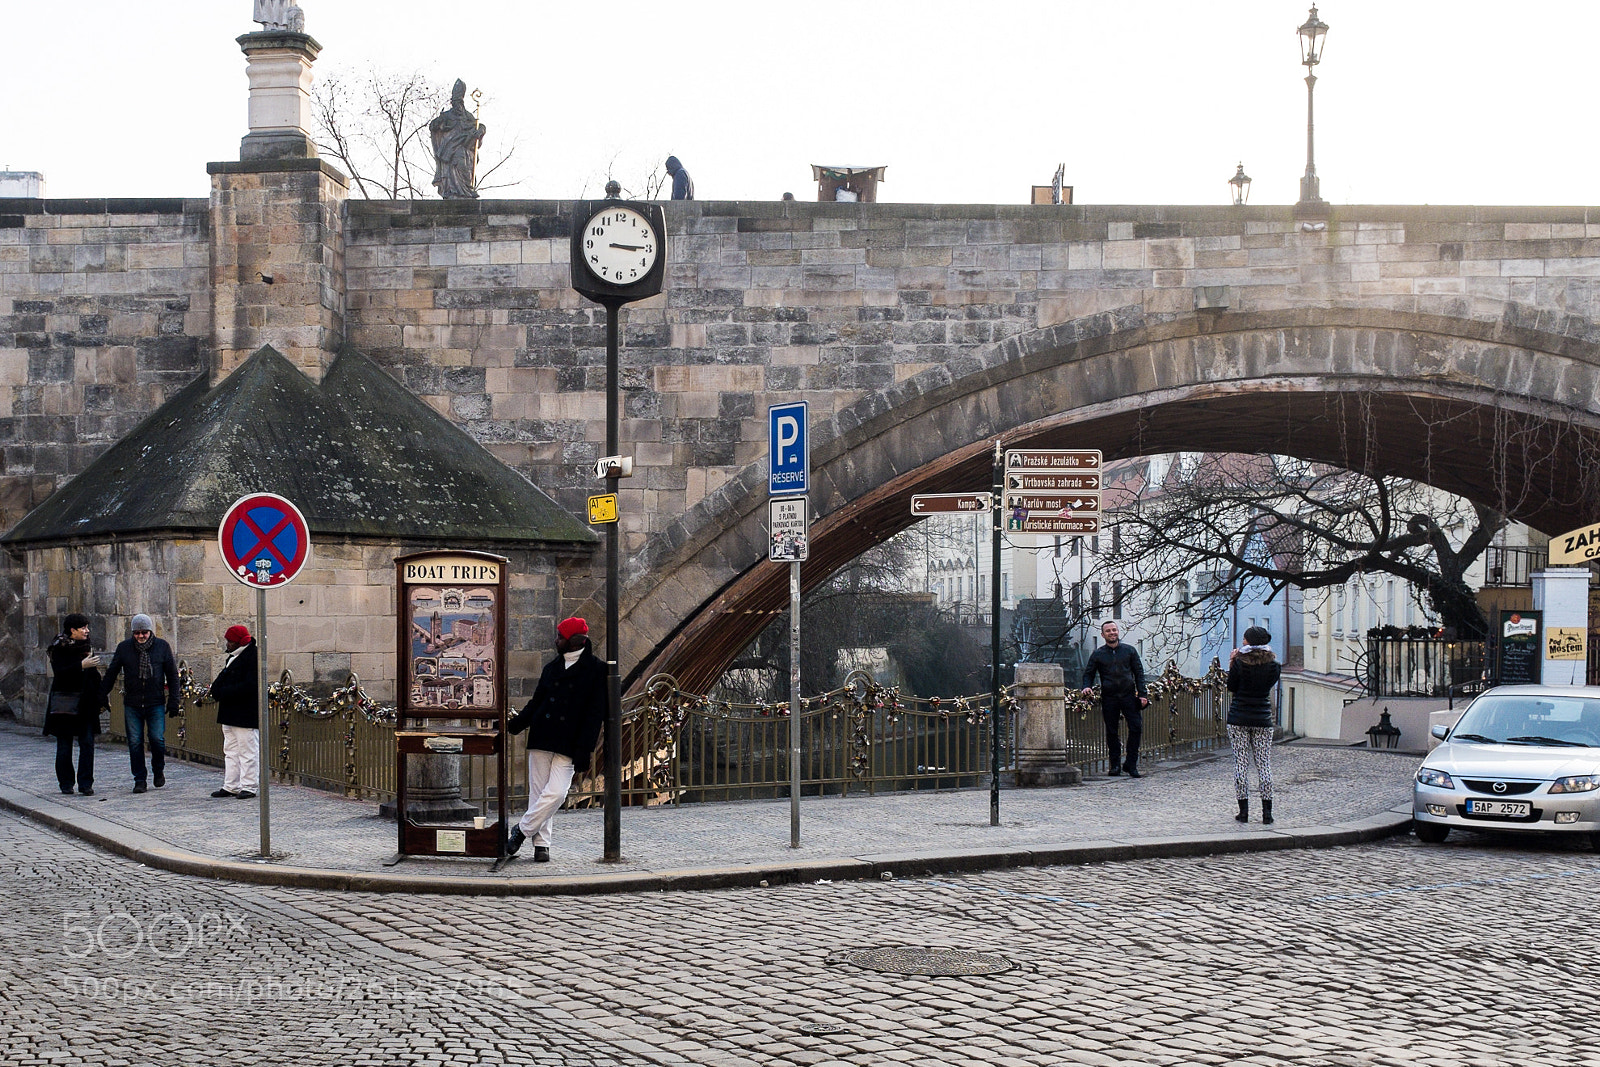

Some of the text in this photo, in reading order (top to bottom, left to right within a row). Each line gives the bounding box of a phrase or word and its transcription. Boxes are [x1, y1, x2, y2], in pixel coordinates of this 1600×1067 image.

[602, 217, 610, 226] 11
[616, 213, 626, 222] 12
[632, 218, 636, 227] 1
[592, 227, 604, 236] 10
[642, 229, 648, 238] 2
[587, 240, 594, 248] 9
[646, 244, 652, 253] 3
[591, 255, 598, 264] 8
[640, 258, 646, 266] 4
[602, 266, 608, 276] 7
[616, 271, 622, 280] 6
[630, 268, 636, 277] 5
[778, 416, 798, 466] P
[1024, 454, 1080, 466] Pražské Jezulátko
[1024, 477, 1082, 487] Vrtbovská zahrada
[958, 499, 976, 510] Kampa
[1024, 498, 1061, 508] Karlův most
[1053, 520, 1083, 530] informace
[407, 564, 496, 580] BOAT TRIPS
[1474, 802, 1492, 812] 5AP
[1500, 804, 1526, 814] 2572
